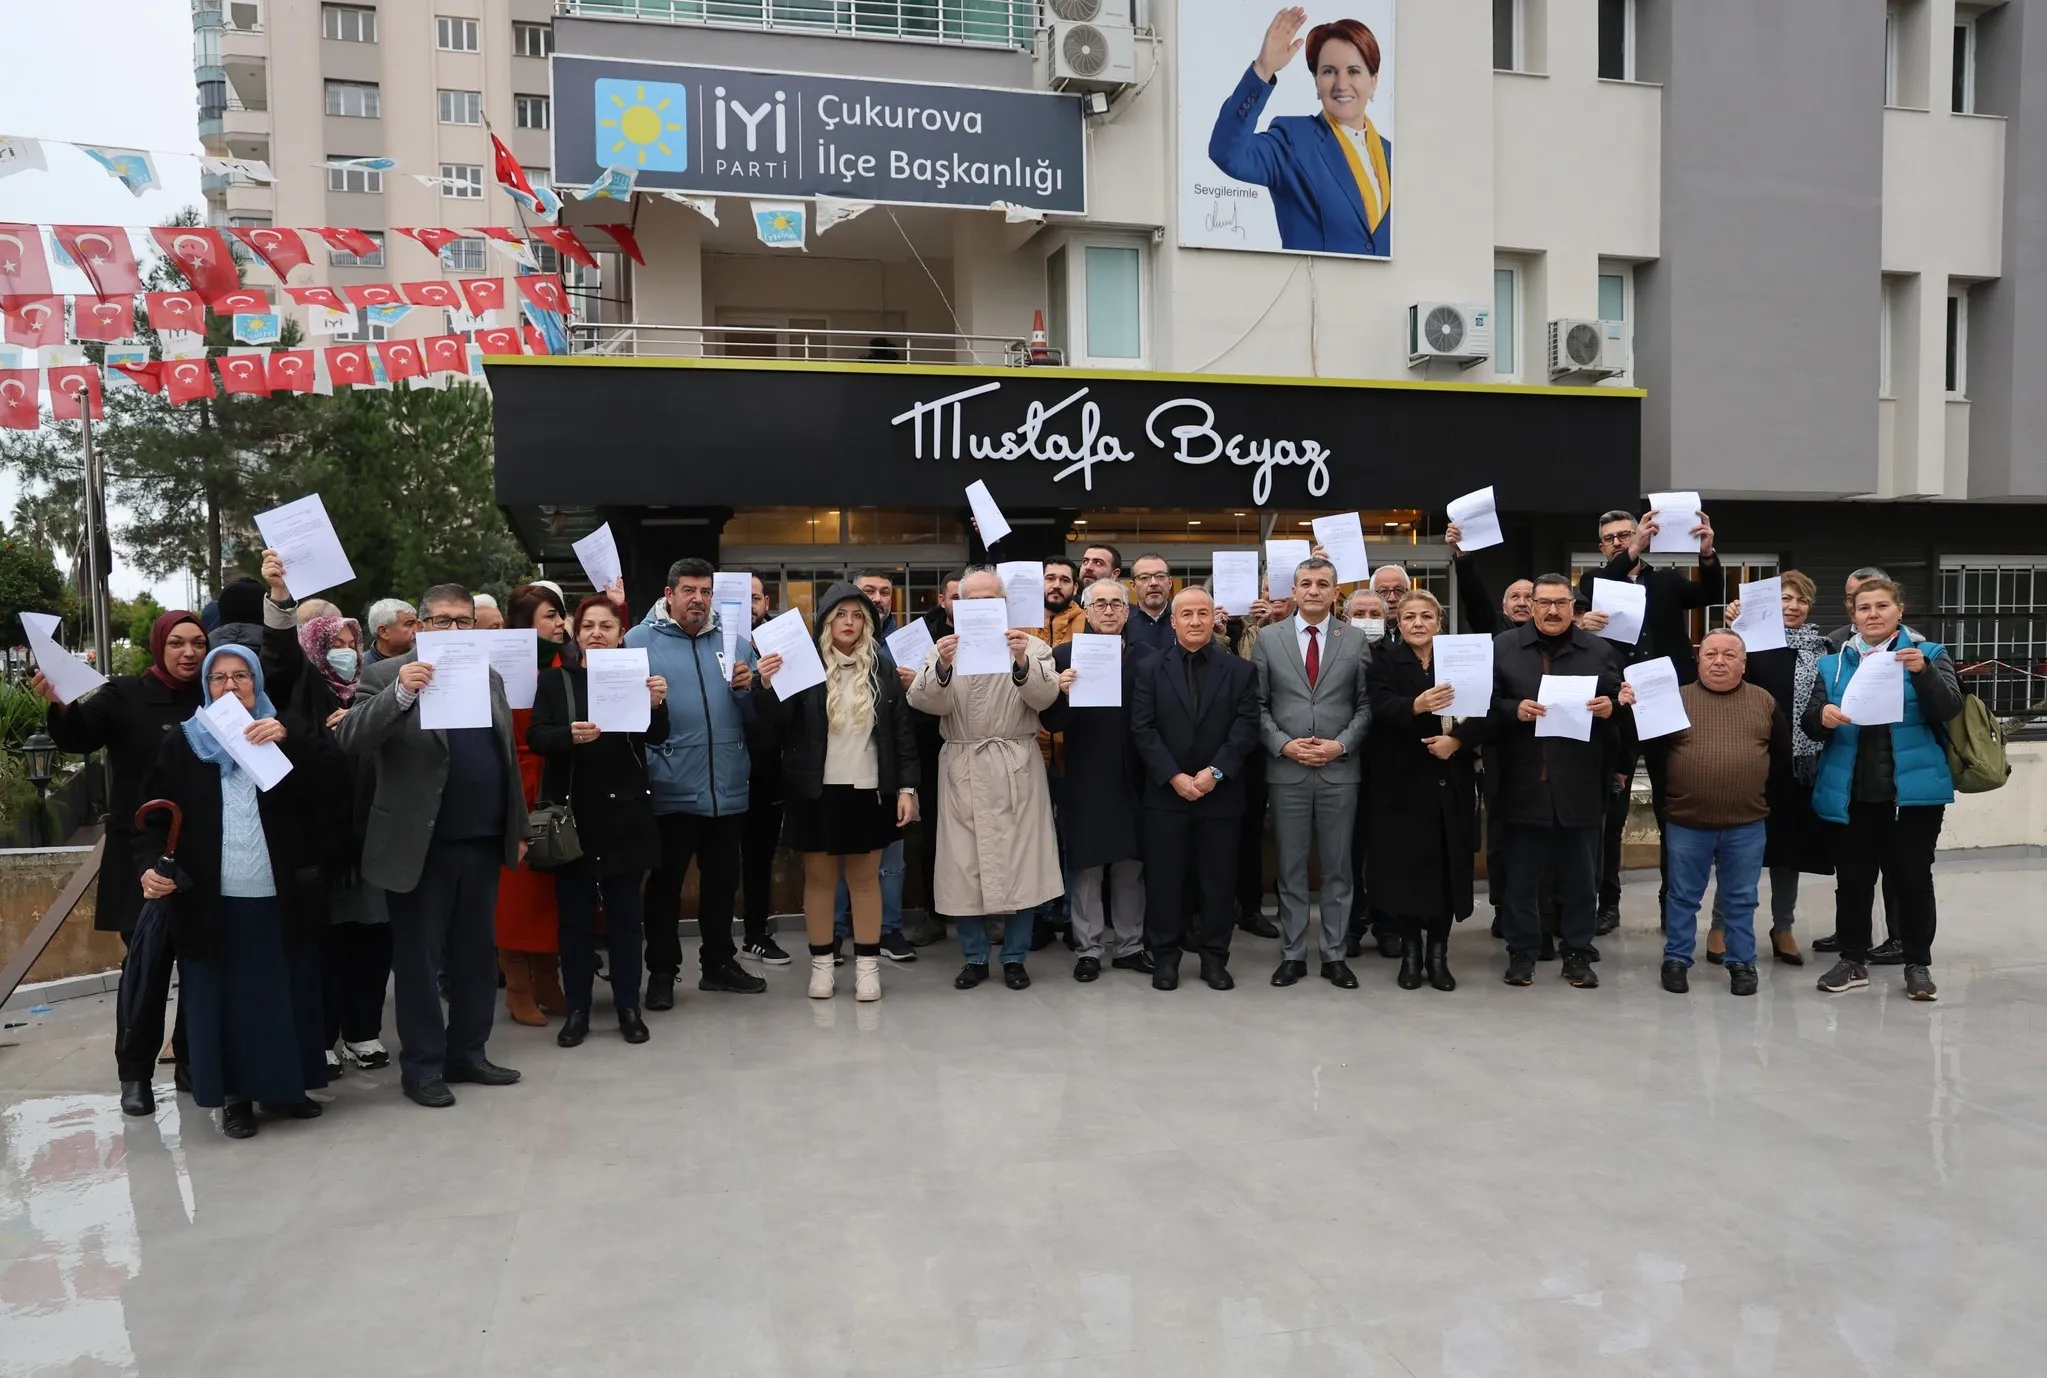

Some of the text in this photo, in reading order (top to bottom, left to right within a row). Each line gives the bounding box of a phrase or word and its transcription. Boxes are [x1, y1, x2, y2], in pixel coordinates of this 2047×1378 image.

[714, 85, 787, 154] İYİ
[817, 94, 984, 134] Çukurova
[817, 138, 1063, 196] İlçe Başkanlığı
[1194, 183, 1259, 199] Sevgilerimle
[891, 381, 1331, 506] Mustafa Beyaz
